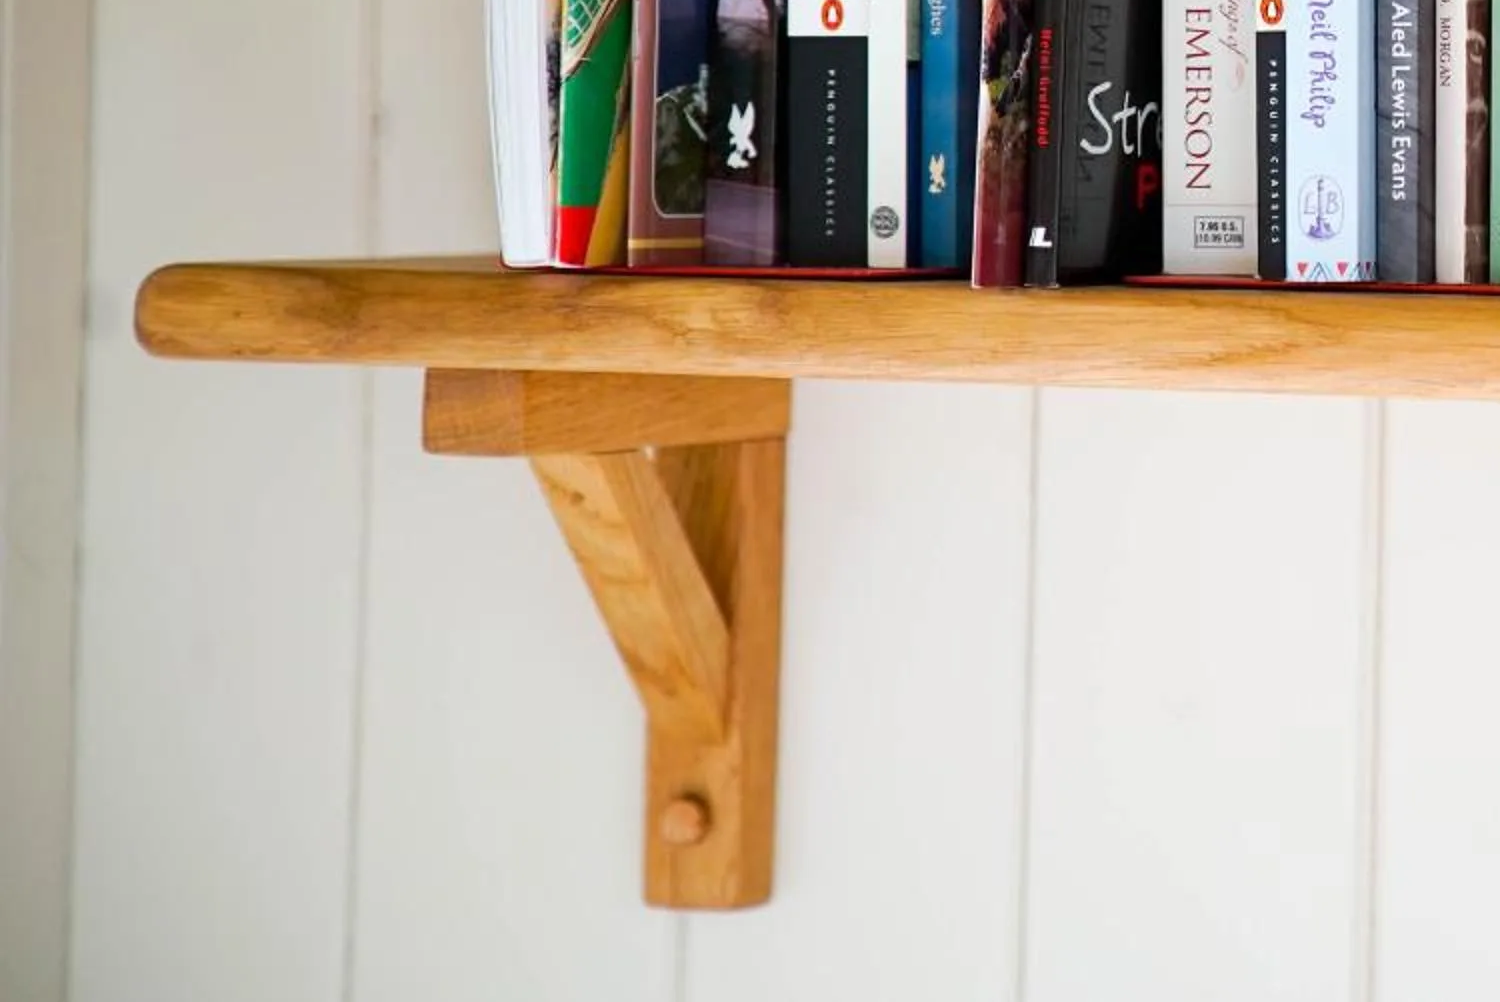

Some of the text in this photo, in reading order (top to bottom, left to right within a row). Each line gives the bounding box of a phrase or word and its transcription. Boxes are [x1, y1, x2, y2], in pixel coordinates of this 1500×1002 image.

[1184, 7, 1213, 190] EMERSON
[1299, 48, 1338, 131] Philip
[1390, 0, 1413, 202] Aled Lewis Evans
[1437, 17, 1452, 89] MORGAN
[824, 68, 837, 237] PENGUIN CLASSICS
[1268, 59, 1281, 246] PENGUIN CLASSICS
